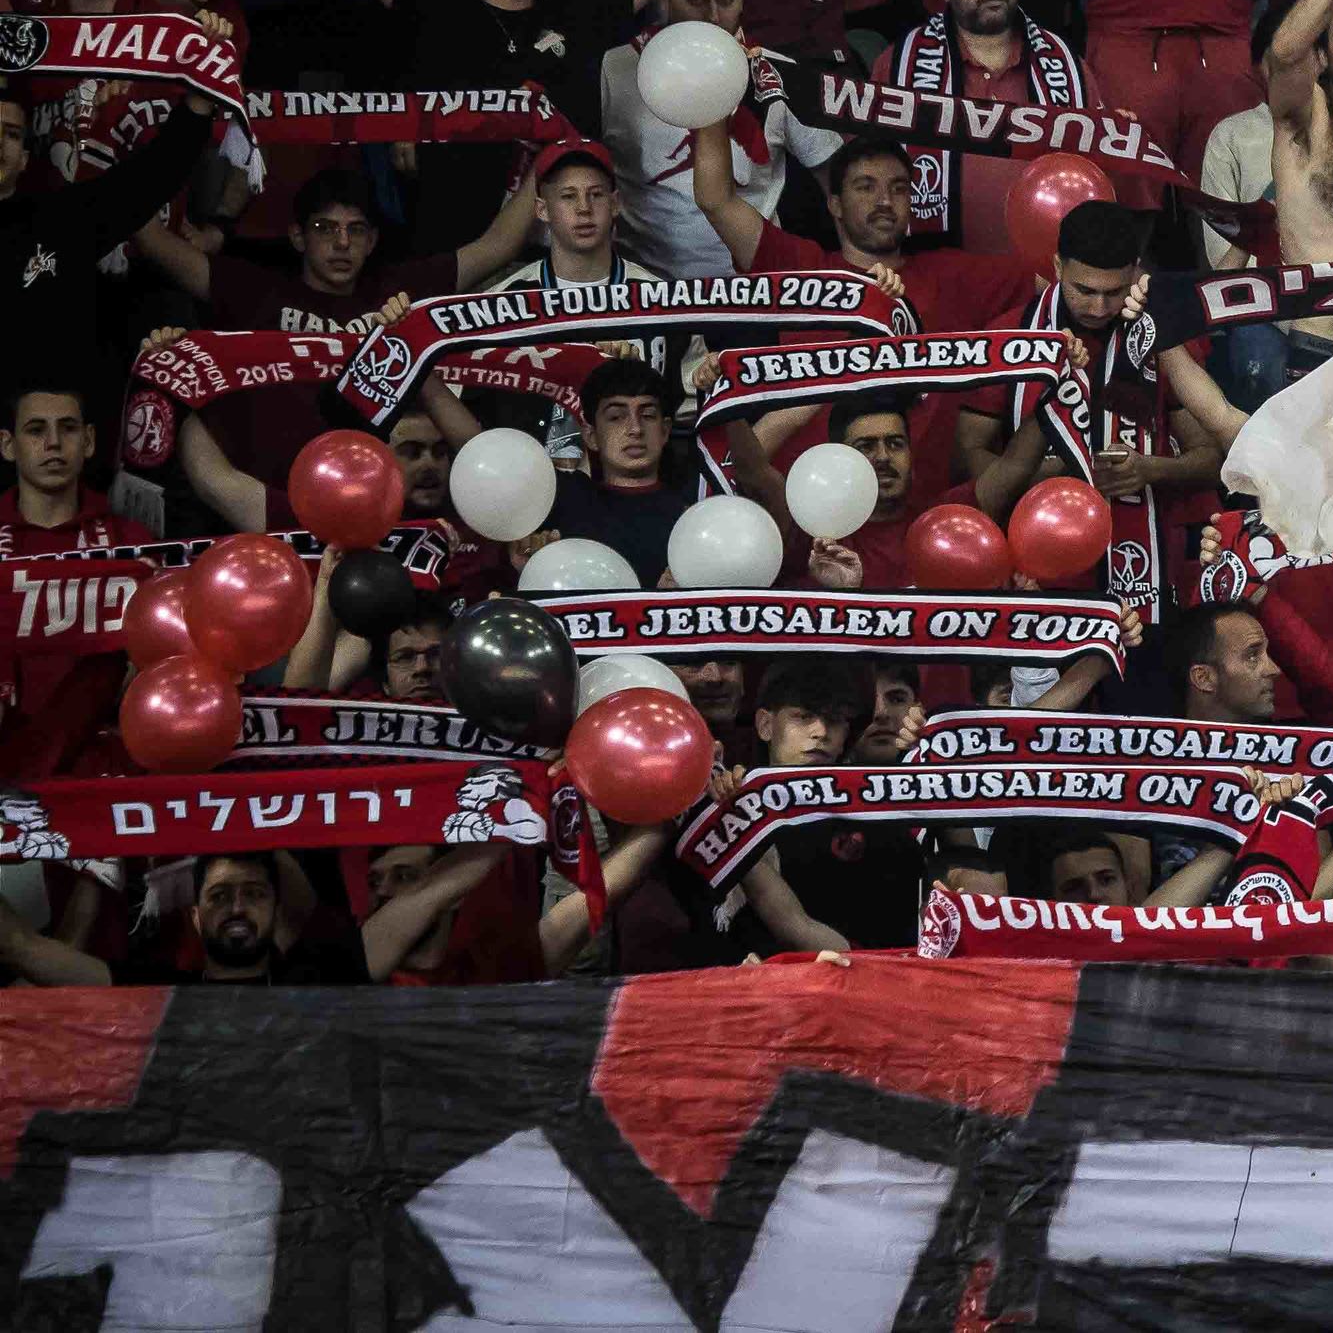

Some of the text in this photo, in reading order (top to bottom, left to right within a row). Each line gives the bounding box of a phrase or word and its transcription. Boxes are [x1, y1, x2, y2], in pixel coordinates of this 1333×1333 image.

[430, 274, 864, 335] FINAL FOUR MALAGA 2023
[237, 362, 295, 388] 2015
[738, 337, 989, 383] JERUSALEM
[1001, 336, 1064, 367] ON
[640, 604, 912, 638] JERUSALEM
[929, 611, 996, 641] ON
[1012, 613, 1121, 647] TOUR
[1030, 726, 1294, 765] JERUSALEM
[111, 787, 414, 836] ירושלים
[696, 776, 848, 864] HAPOEL
[861, 771, 1123, 803] JERUSALEM
[1137, 776, 1203, 807] ON
